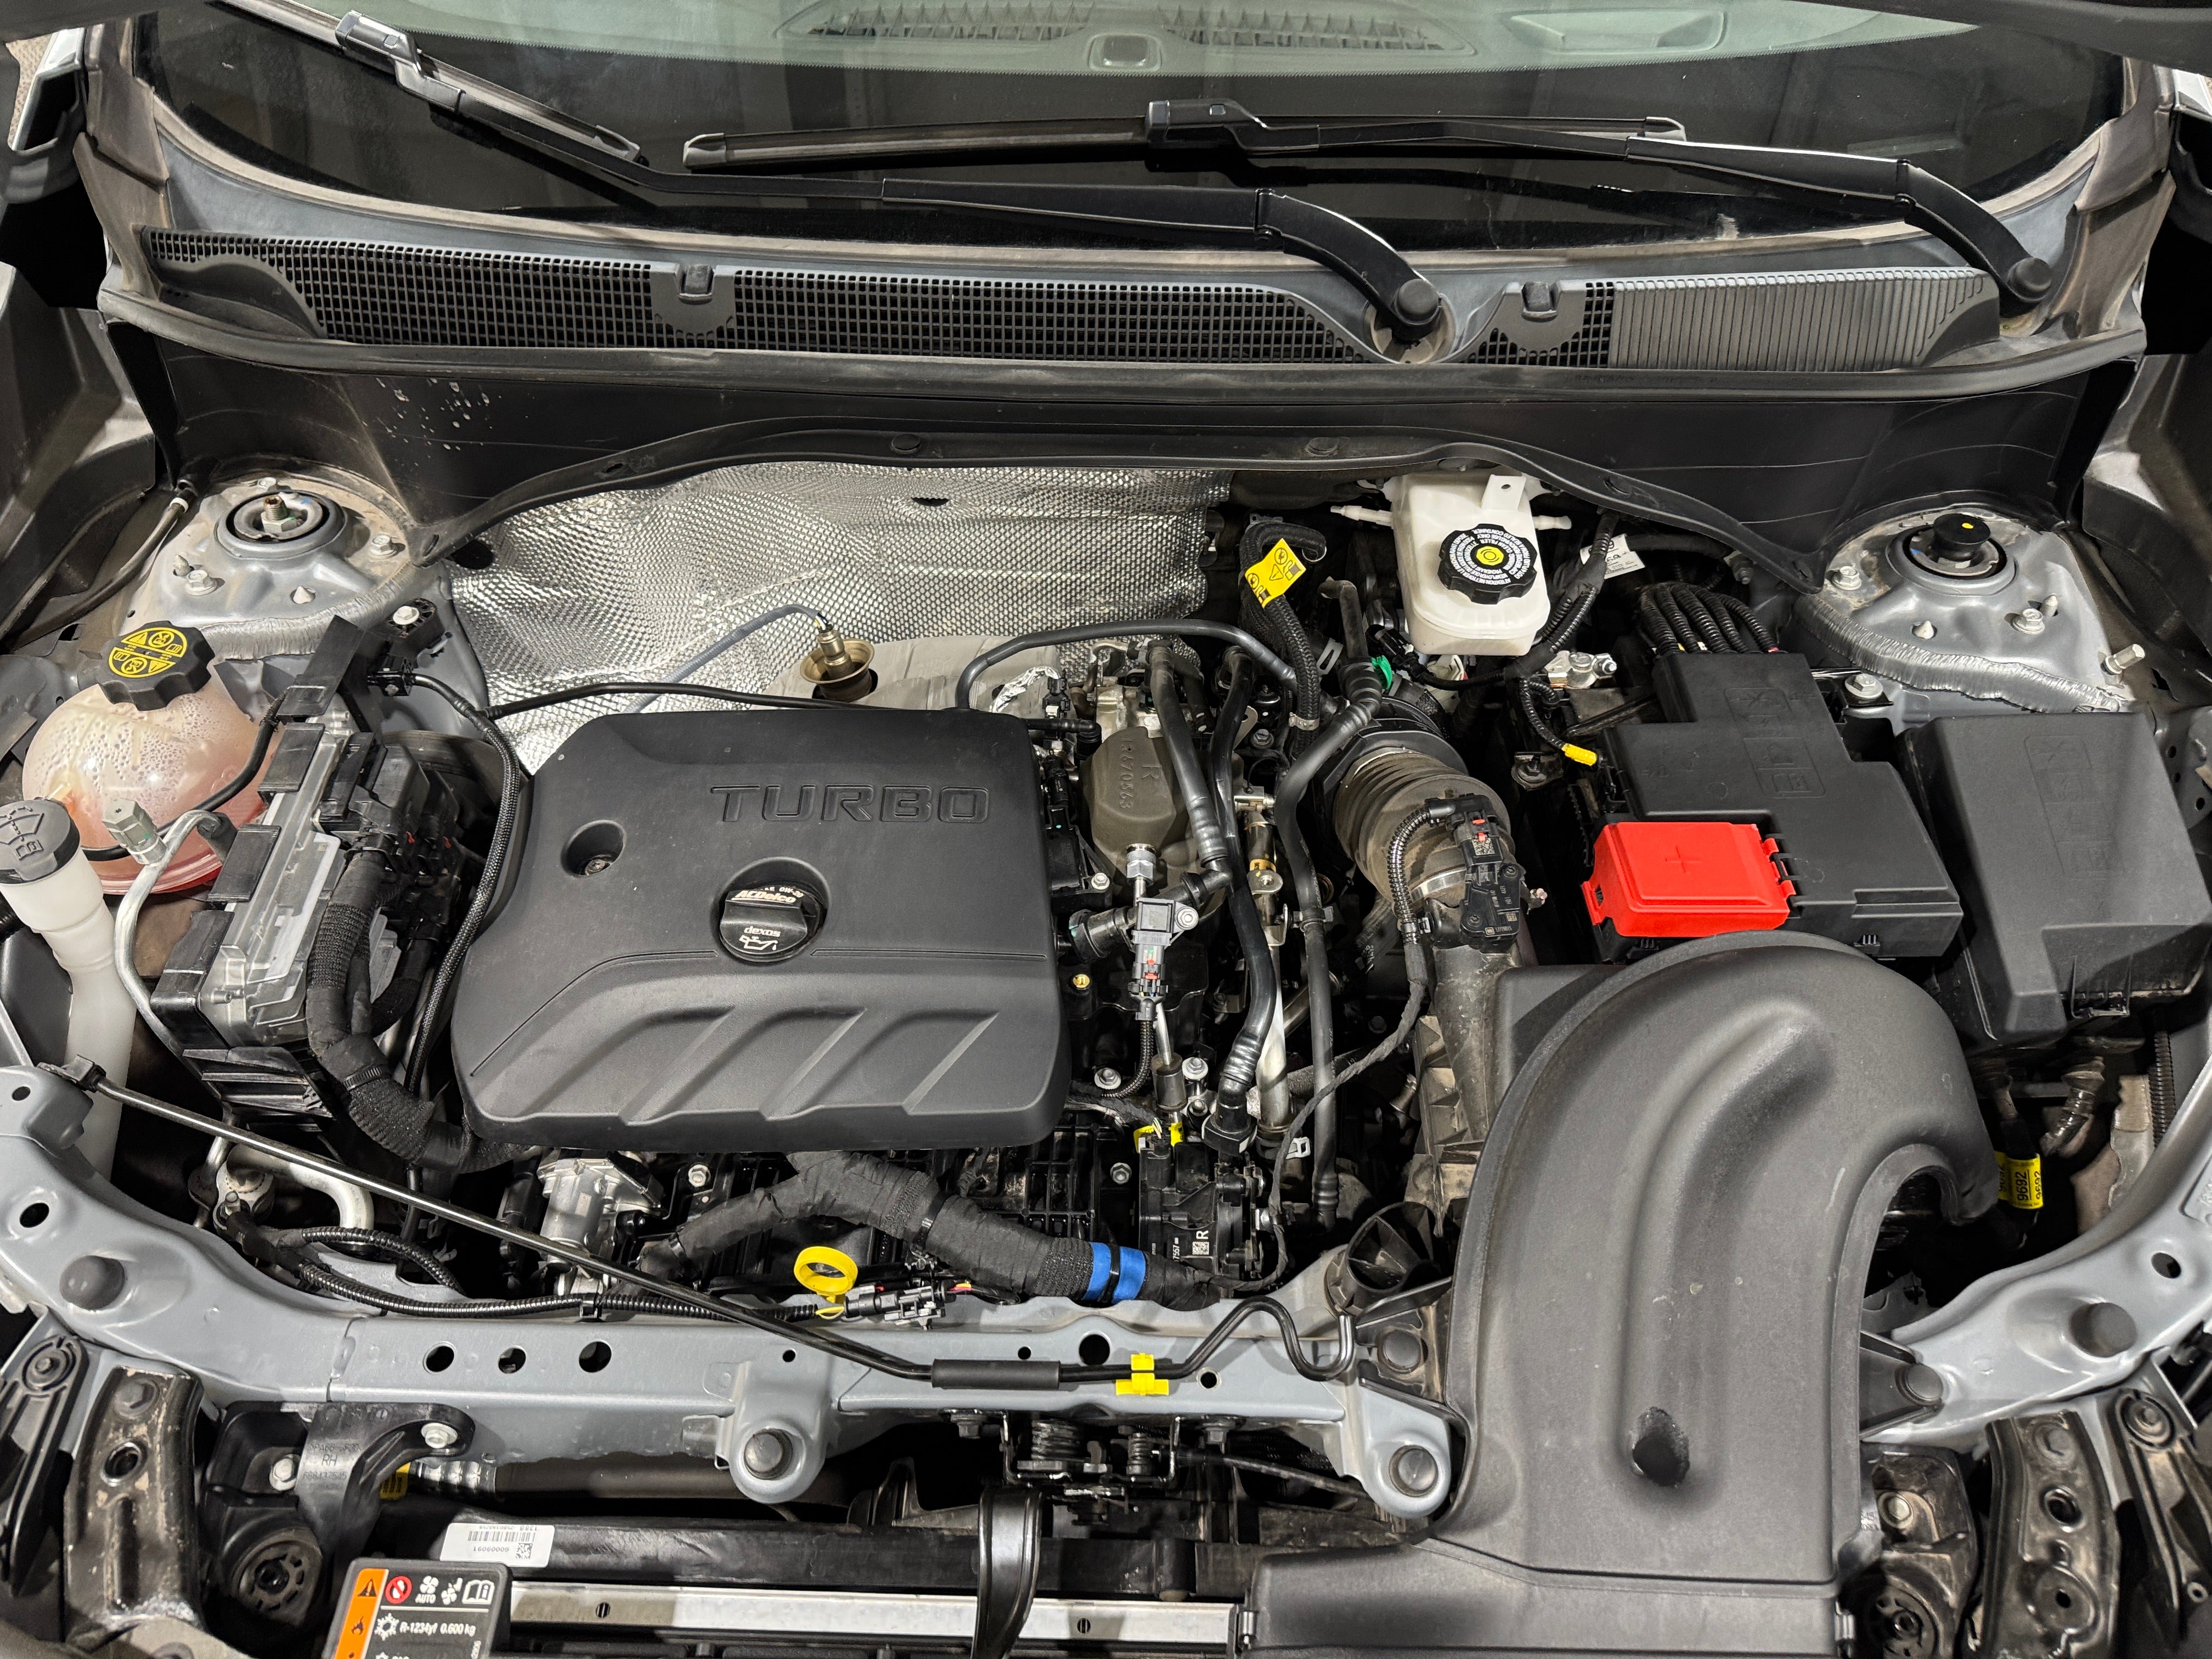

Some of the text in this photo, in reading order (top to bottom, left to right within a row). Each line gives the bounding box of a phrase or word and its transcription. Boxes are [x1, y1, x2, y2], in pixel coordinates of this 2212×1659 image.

[1503, 532, 1522, 545] SEALED
[1498, 541, 1513, 552] CLEAN
[1521, 547, 1529, 557] FROM
[1521, 559, 1530, 569] FLUID
[1142, 763, 1160, 780] R
[710, 785, 990, 823] TURBO
[735, 890, 796, 904] ACDelco
[779, 887, 804, 898] 0W-20
[743, 926, 781, 938] dexos
[2017, 1171, 2029, 1201] 9692
[1195, 1230, 1209, 1239] R
[321, 1454, 338, 1466] RH
[415, 1594, 436, 1604] AUTO
[439, 1623, 464, 1635] 0.600
[465, 1624, 476, 1637] kg
